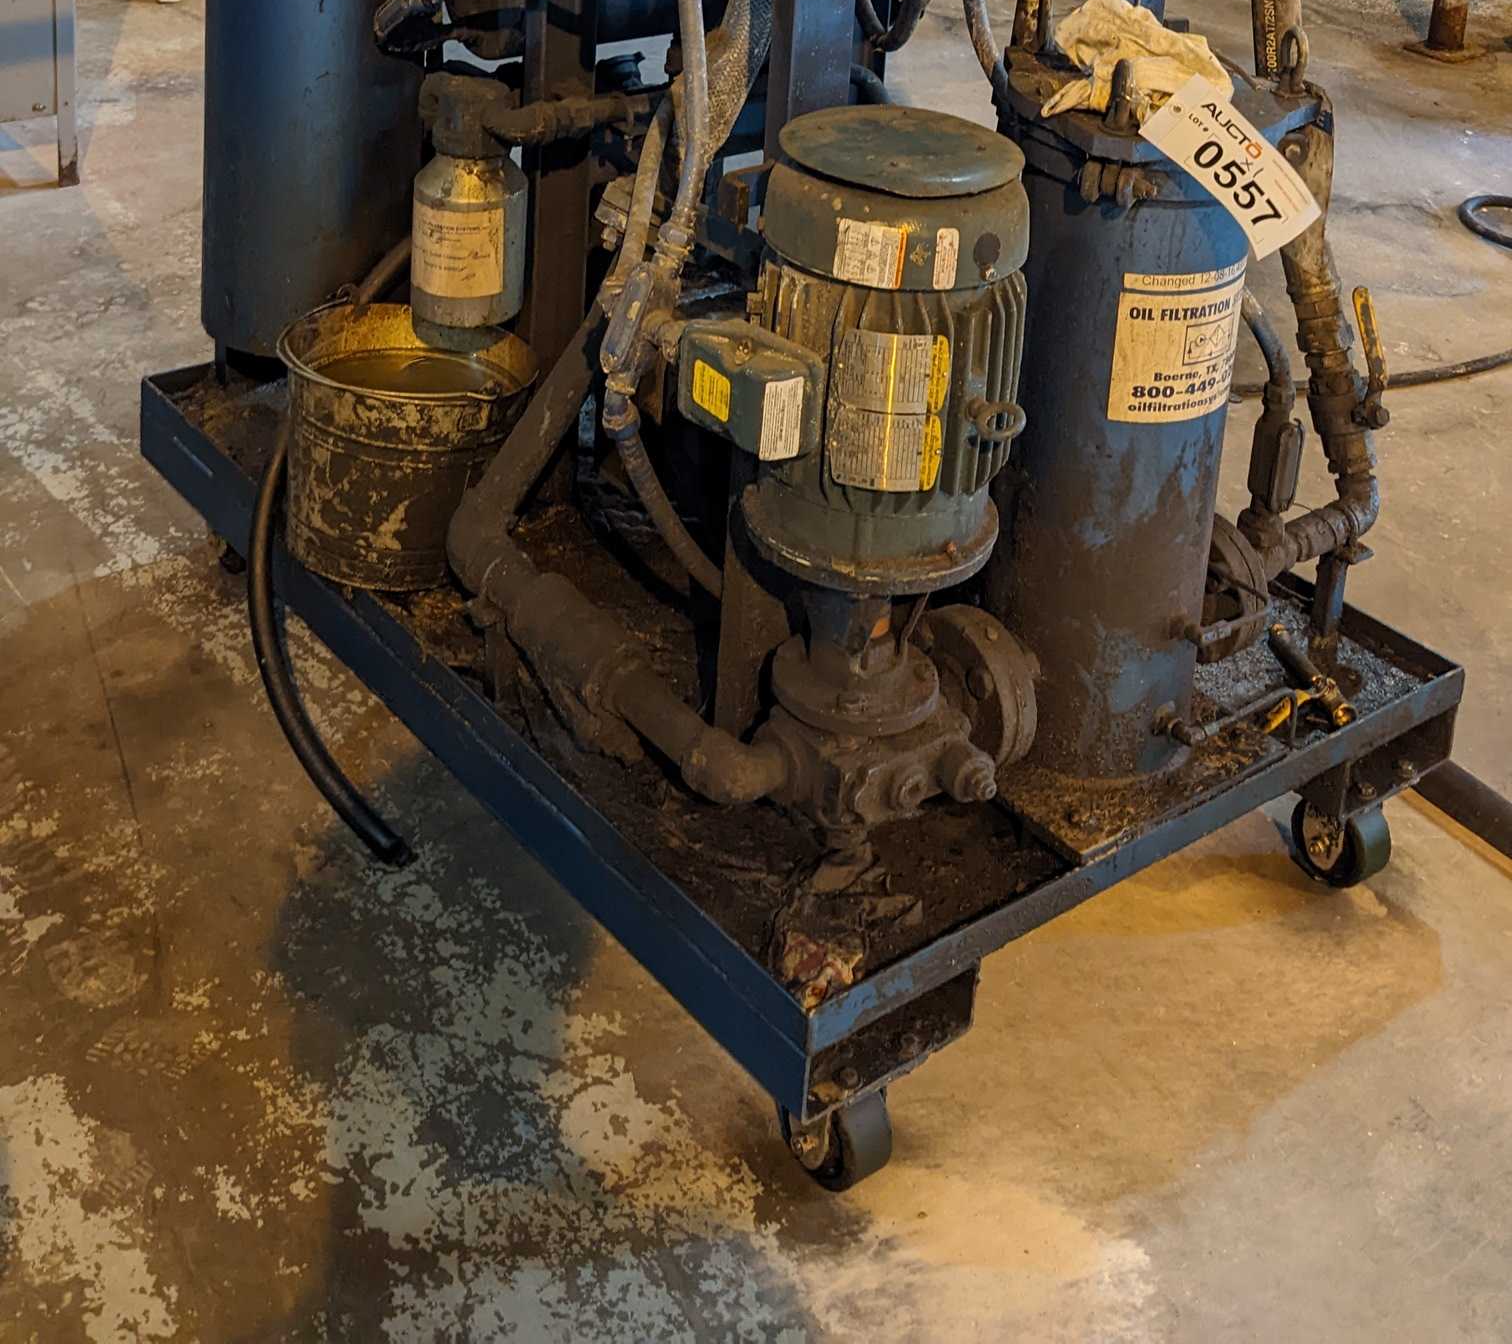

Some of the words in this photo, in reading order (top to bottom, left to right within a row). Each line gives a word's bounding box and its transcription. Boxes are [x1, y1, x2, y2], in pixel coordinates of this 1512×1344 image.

[1188, 113, 1202, 128] LOT
[1193, 140, 1283, 226] 0557
[1142, 274, 1195, 289] Changed
[1129, 307, 1155, 321] OIL
[1160, 297, 1231, 322] FILTRATION
[1153, 371, 1202, 382] Boerne,
